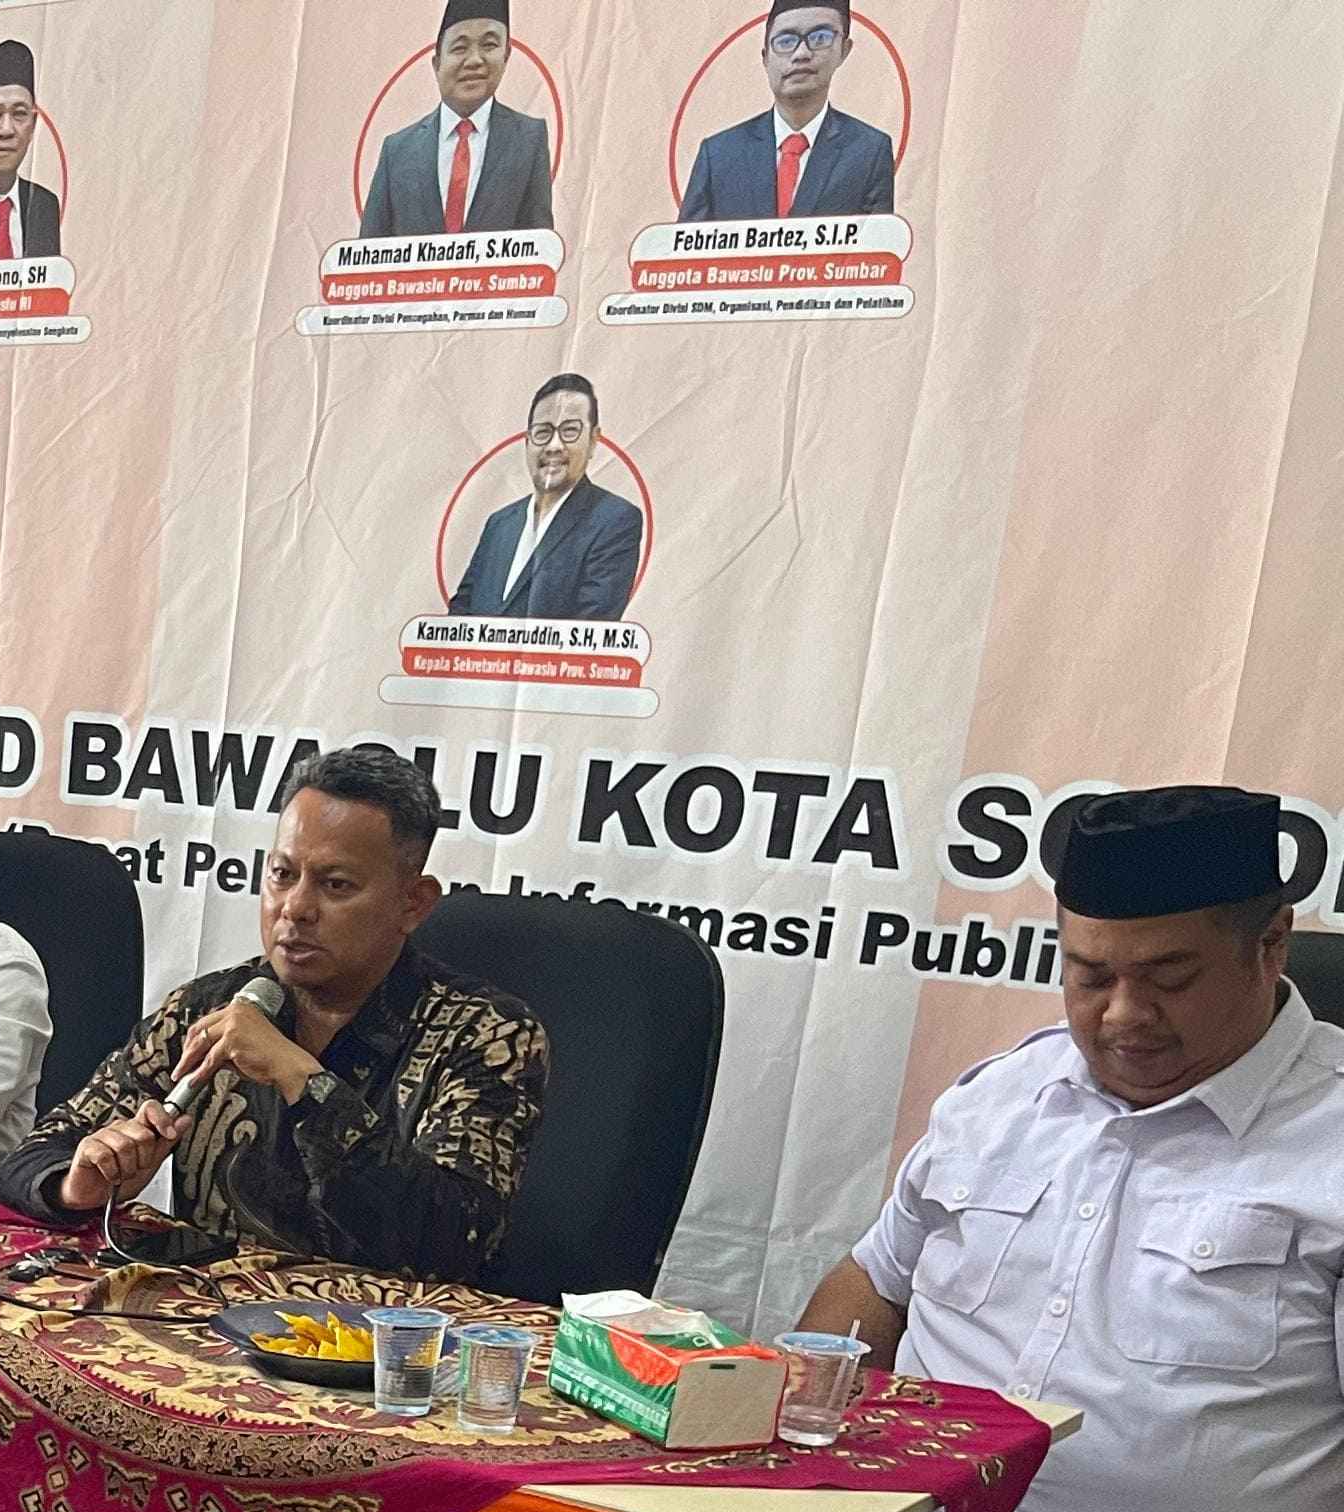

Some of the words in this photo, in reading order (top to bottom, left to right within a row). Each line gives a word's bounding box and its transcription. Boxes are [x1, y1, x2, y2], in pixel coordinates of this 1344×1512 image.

[673, 228, 738, 251] Febrian
[745, 225, 807, 250] Bartez,
[815, 224, 858, 246] S.I.P.
[338, 244, 411, 266] Muhamad
[417, 240, 480, 263] Khadafi,
[486, 238, 539, 258] S.Kom.
[28, 266, 47, 284] SH
[328, 282, 383, 300] Anggota
[387, 279, 445, 295] Bawaslu
[449, 278, 483, 293] Prov.
[488, 275, 543, 291] Sumbar
[638, 269, 702, 289] Anggota
[707, 266, 772, 283] Bawaslu
[778, 264, 818, 281] Prov.
[824, 262, 887, 280] Sumbar
[20, 295, 32, 310] RI
[691, 302, 715, 314] SDM,
[834, 298, 853, 310] dan
[417, 622, 474, 642] Karnalis
[478, 624, 564, 649] Kamaruddin,
[569, 628, 597, 651] S.H,
[603, 629, 639, 649] M.Si.
[414, 655, 450, 672] Kepala
[453, 657, 510, 673] Sekretariat
[513, 660, 556, 676] Bawaslu
[589, 663, 632, 680] Sumbar
[577, 758, 900, 869] KOTA
[859, 910, 1064, 986] Publi
